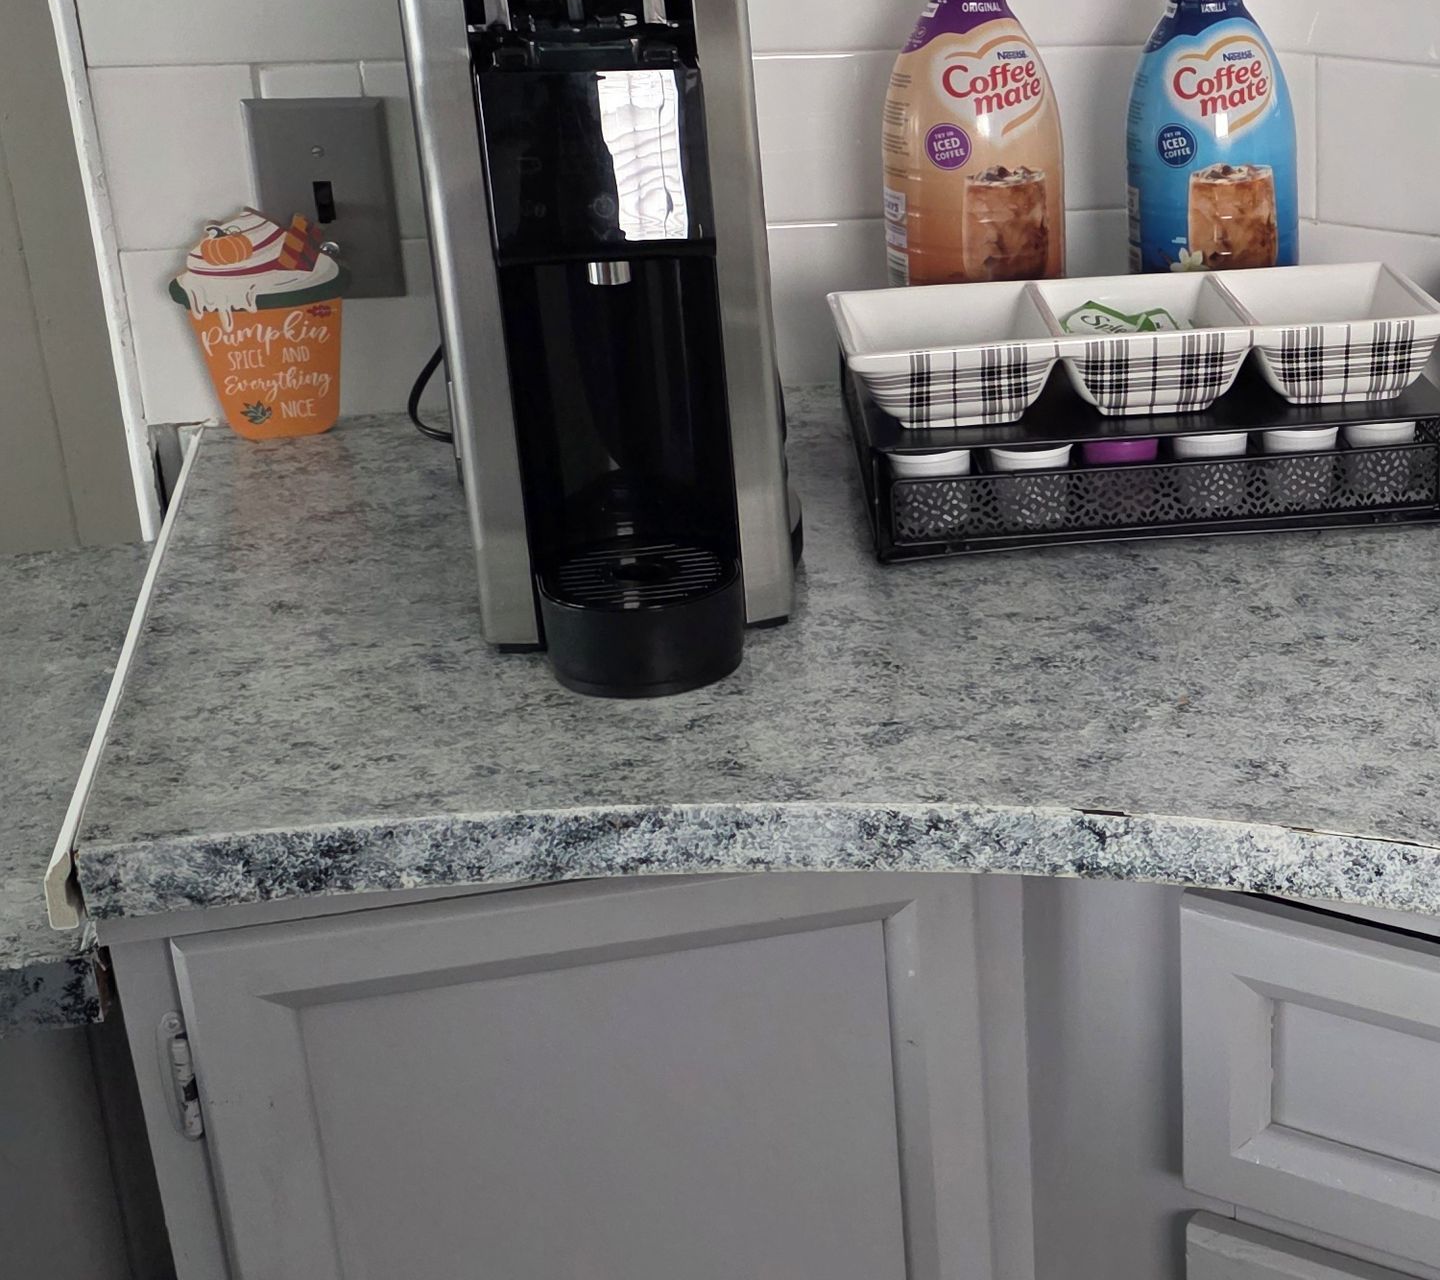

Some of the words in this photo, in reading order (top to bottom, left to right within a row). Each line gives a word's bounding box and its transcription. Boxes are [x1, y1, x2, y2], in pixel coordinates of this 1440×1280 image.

[962, 2, 1003, 13] ORIGINAL
[1200, 2, 1227, 13] VANILLA
[942, 60, 1036, 98] Coffee
[1173, 60, 1262, 100] Coffee
[974, 77, 1041, 116] mate
[1200, 77, 1267, 116] mate
[933, 137, 961, 152] ICED
[935, 148, 965, 161] COFFEE
[1162, 137, 1187, 150] ICED
[1164, 147, 1191, 159] COFFEE
[201, 310, 331, 357] Pumpkin
[227, 349, 266, 371] SPICE
[281, 346, 310, 363] AND
[224, 366, 332, 403] Everything
[280, 398, 317, 419] NICE
